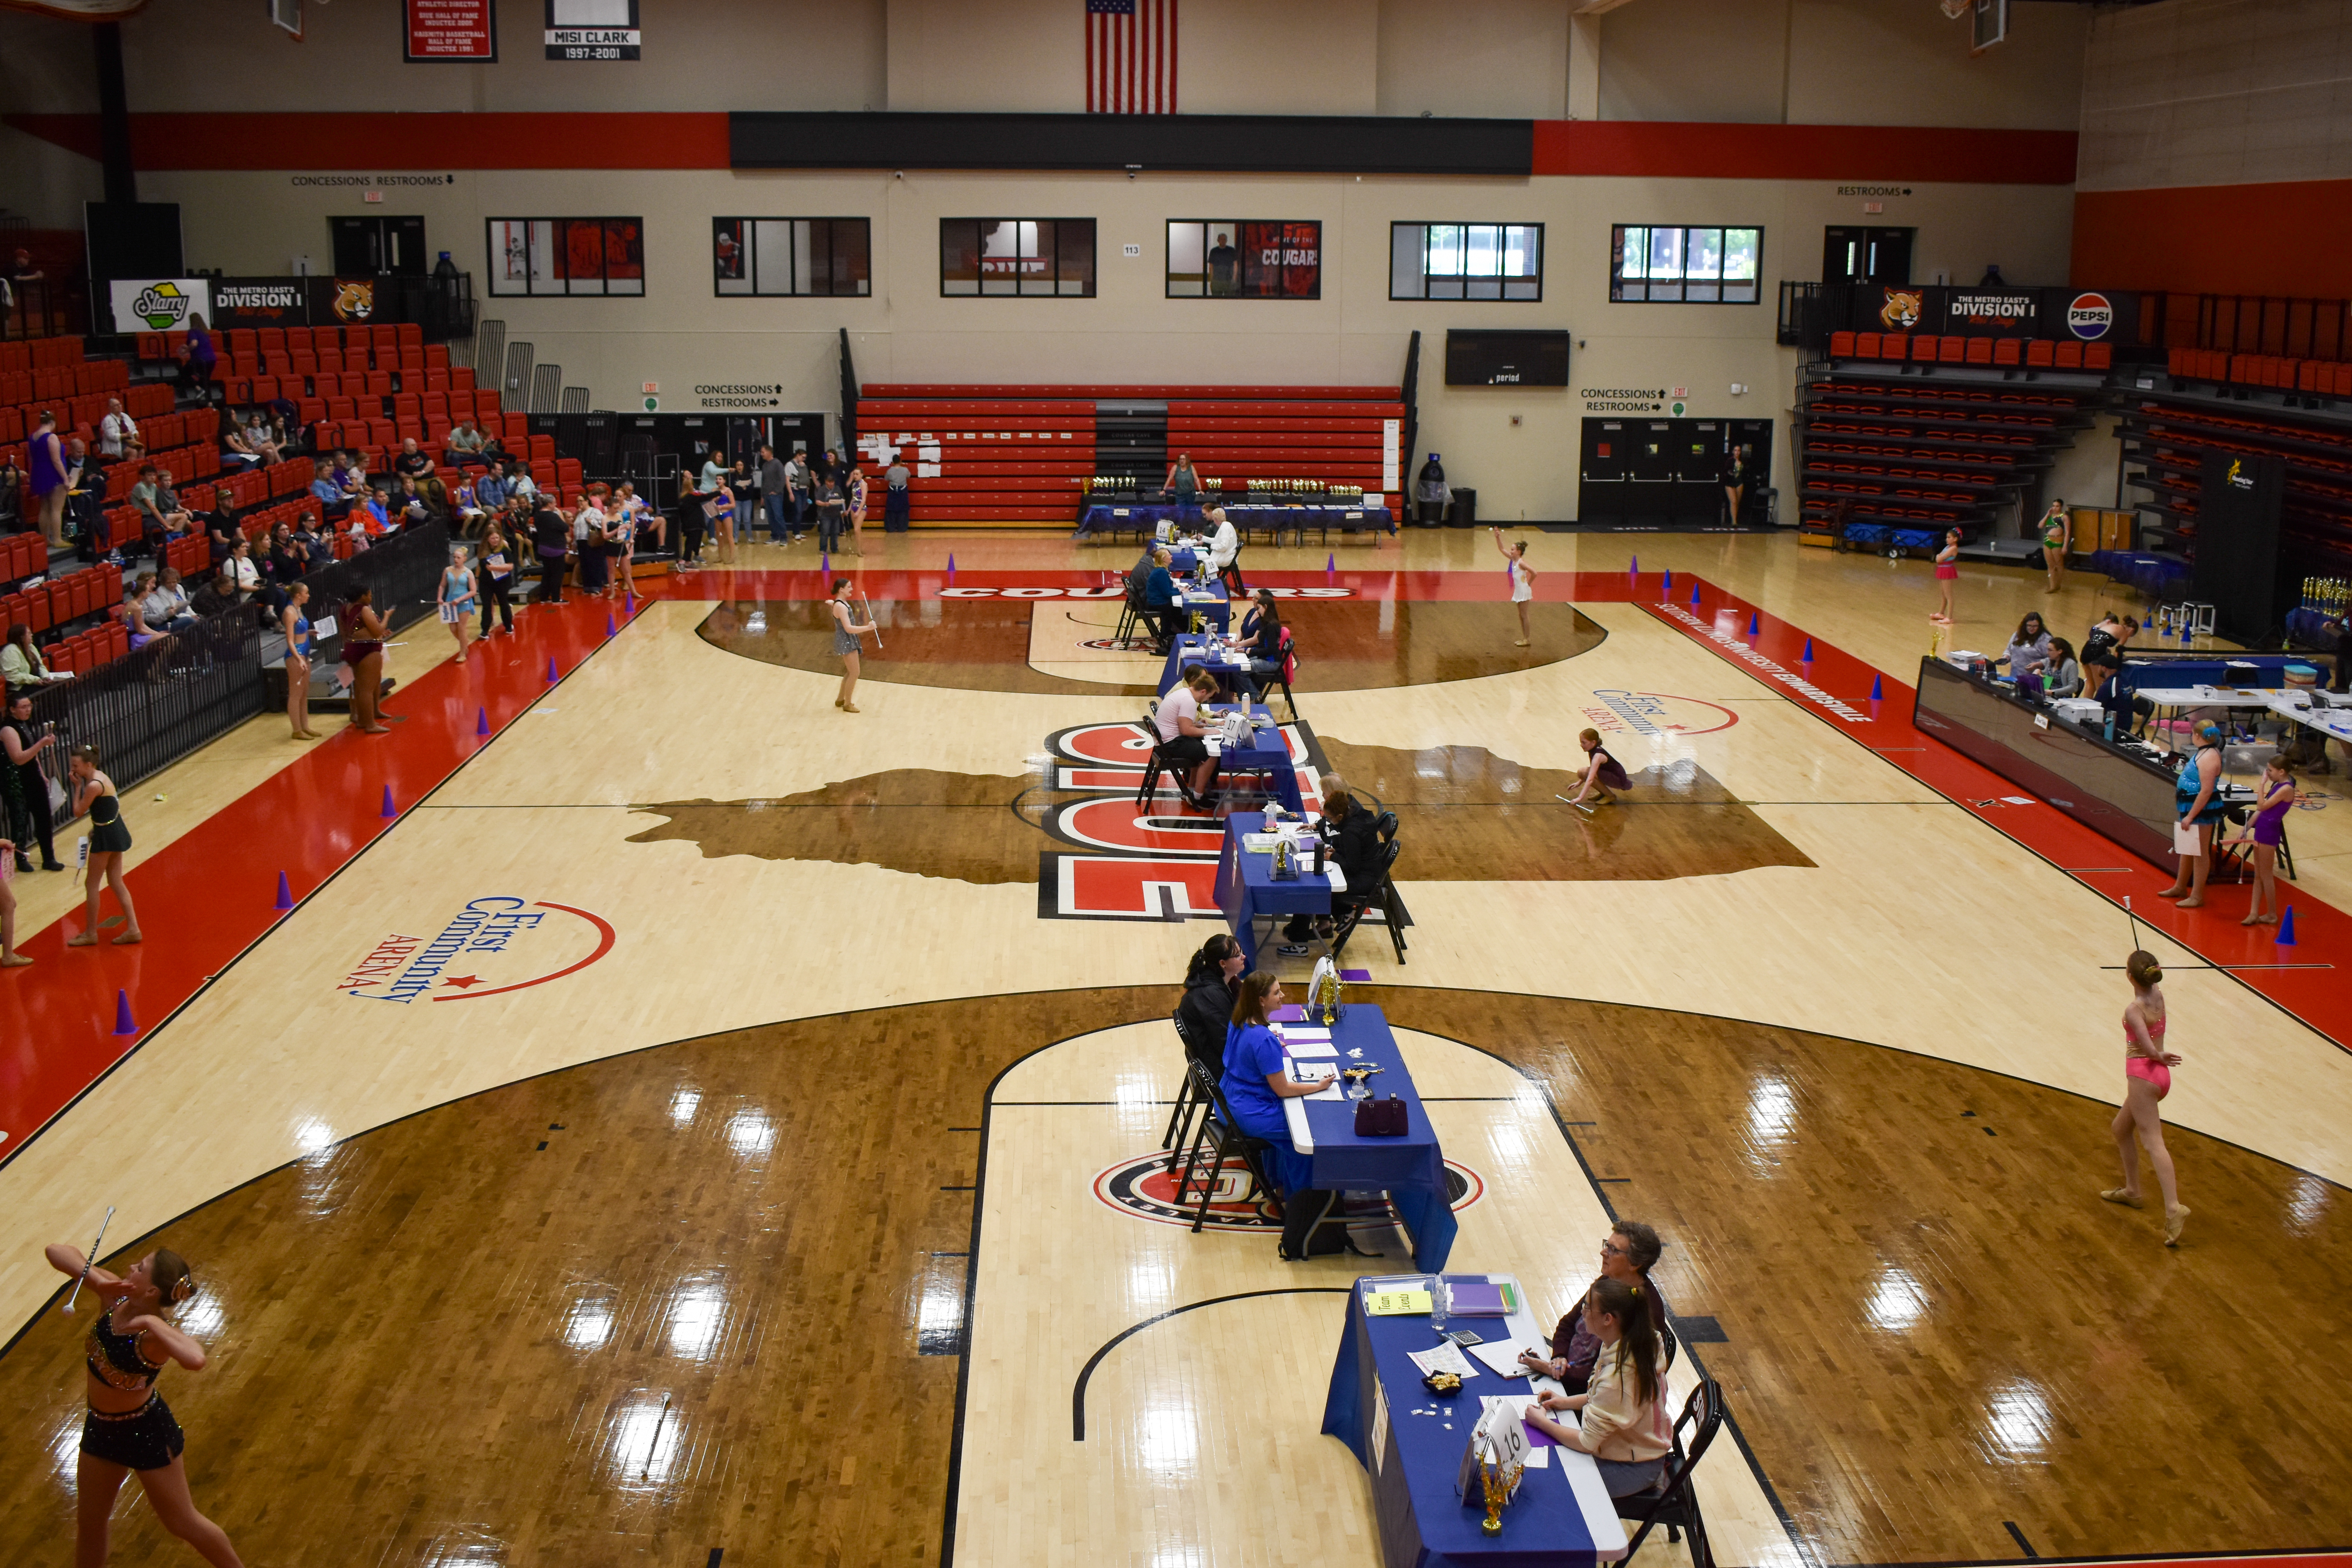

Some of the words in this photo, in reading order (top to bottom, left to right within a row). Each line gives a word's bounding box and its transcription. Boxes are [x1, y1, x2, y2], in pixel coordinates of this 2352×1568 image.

[555, 32, 581, 43] MISI
[586, 32, 629, 43] CLARK
[566, 48, 620, 59] 1997-2001
[292, 176, 371, 185] CONCESSIONS
[377, 176, 443, 185] RESTROOMS
[1837, 186, 1900, 196] RESTROOMS
[133, 288, 189, 321] Starry
[217, 294, 292, 307] DIVISION
[297, 294, 302, 306] I
[1952, 303, 2025, 317] DIVISION
[2030, 304, 2036, 317] I
[2071, 311, 2109, 321] PEPSI
[1496, 373, 1520, 384] period
[694, 385, 773, 394] CONCESSIONS
[1581, 389, 1656, 399] CONCESSIONS
[1674, 388, 1685, 396] EXIT
[702, 398, 767, 407] RESTROOMS
[1586, 402, 1649, 411] RESTROOMS
[939, 588, 1350, 598] COURS
[1654, 603, 1707, 625] SOUTHERN
[1691, 625, 1740, 644] ILLINOIS
[1723, 642, 1790, 673] UNIVERSITY
[1771, 673, 1873, 722] EDWARDSVILLE
[1623, 697, 1669, 715] First
[1578, 707, 1626, 731] ARENA
[1593, 689, 1664, 737] Community
[1227, 719, 1236, 731] 17
[465, 911, 546, 953] First
[349, 896, 525, 1004] Community
[336, 934, 425, 990] ARENA
[1118, 1196, 1263, 1225] VALEY
[1378, 1296, 1391, 1311] Team
[1399, 1293, 1411, 1310] Events
[1504, 1424, 1521, 1461] 16
